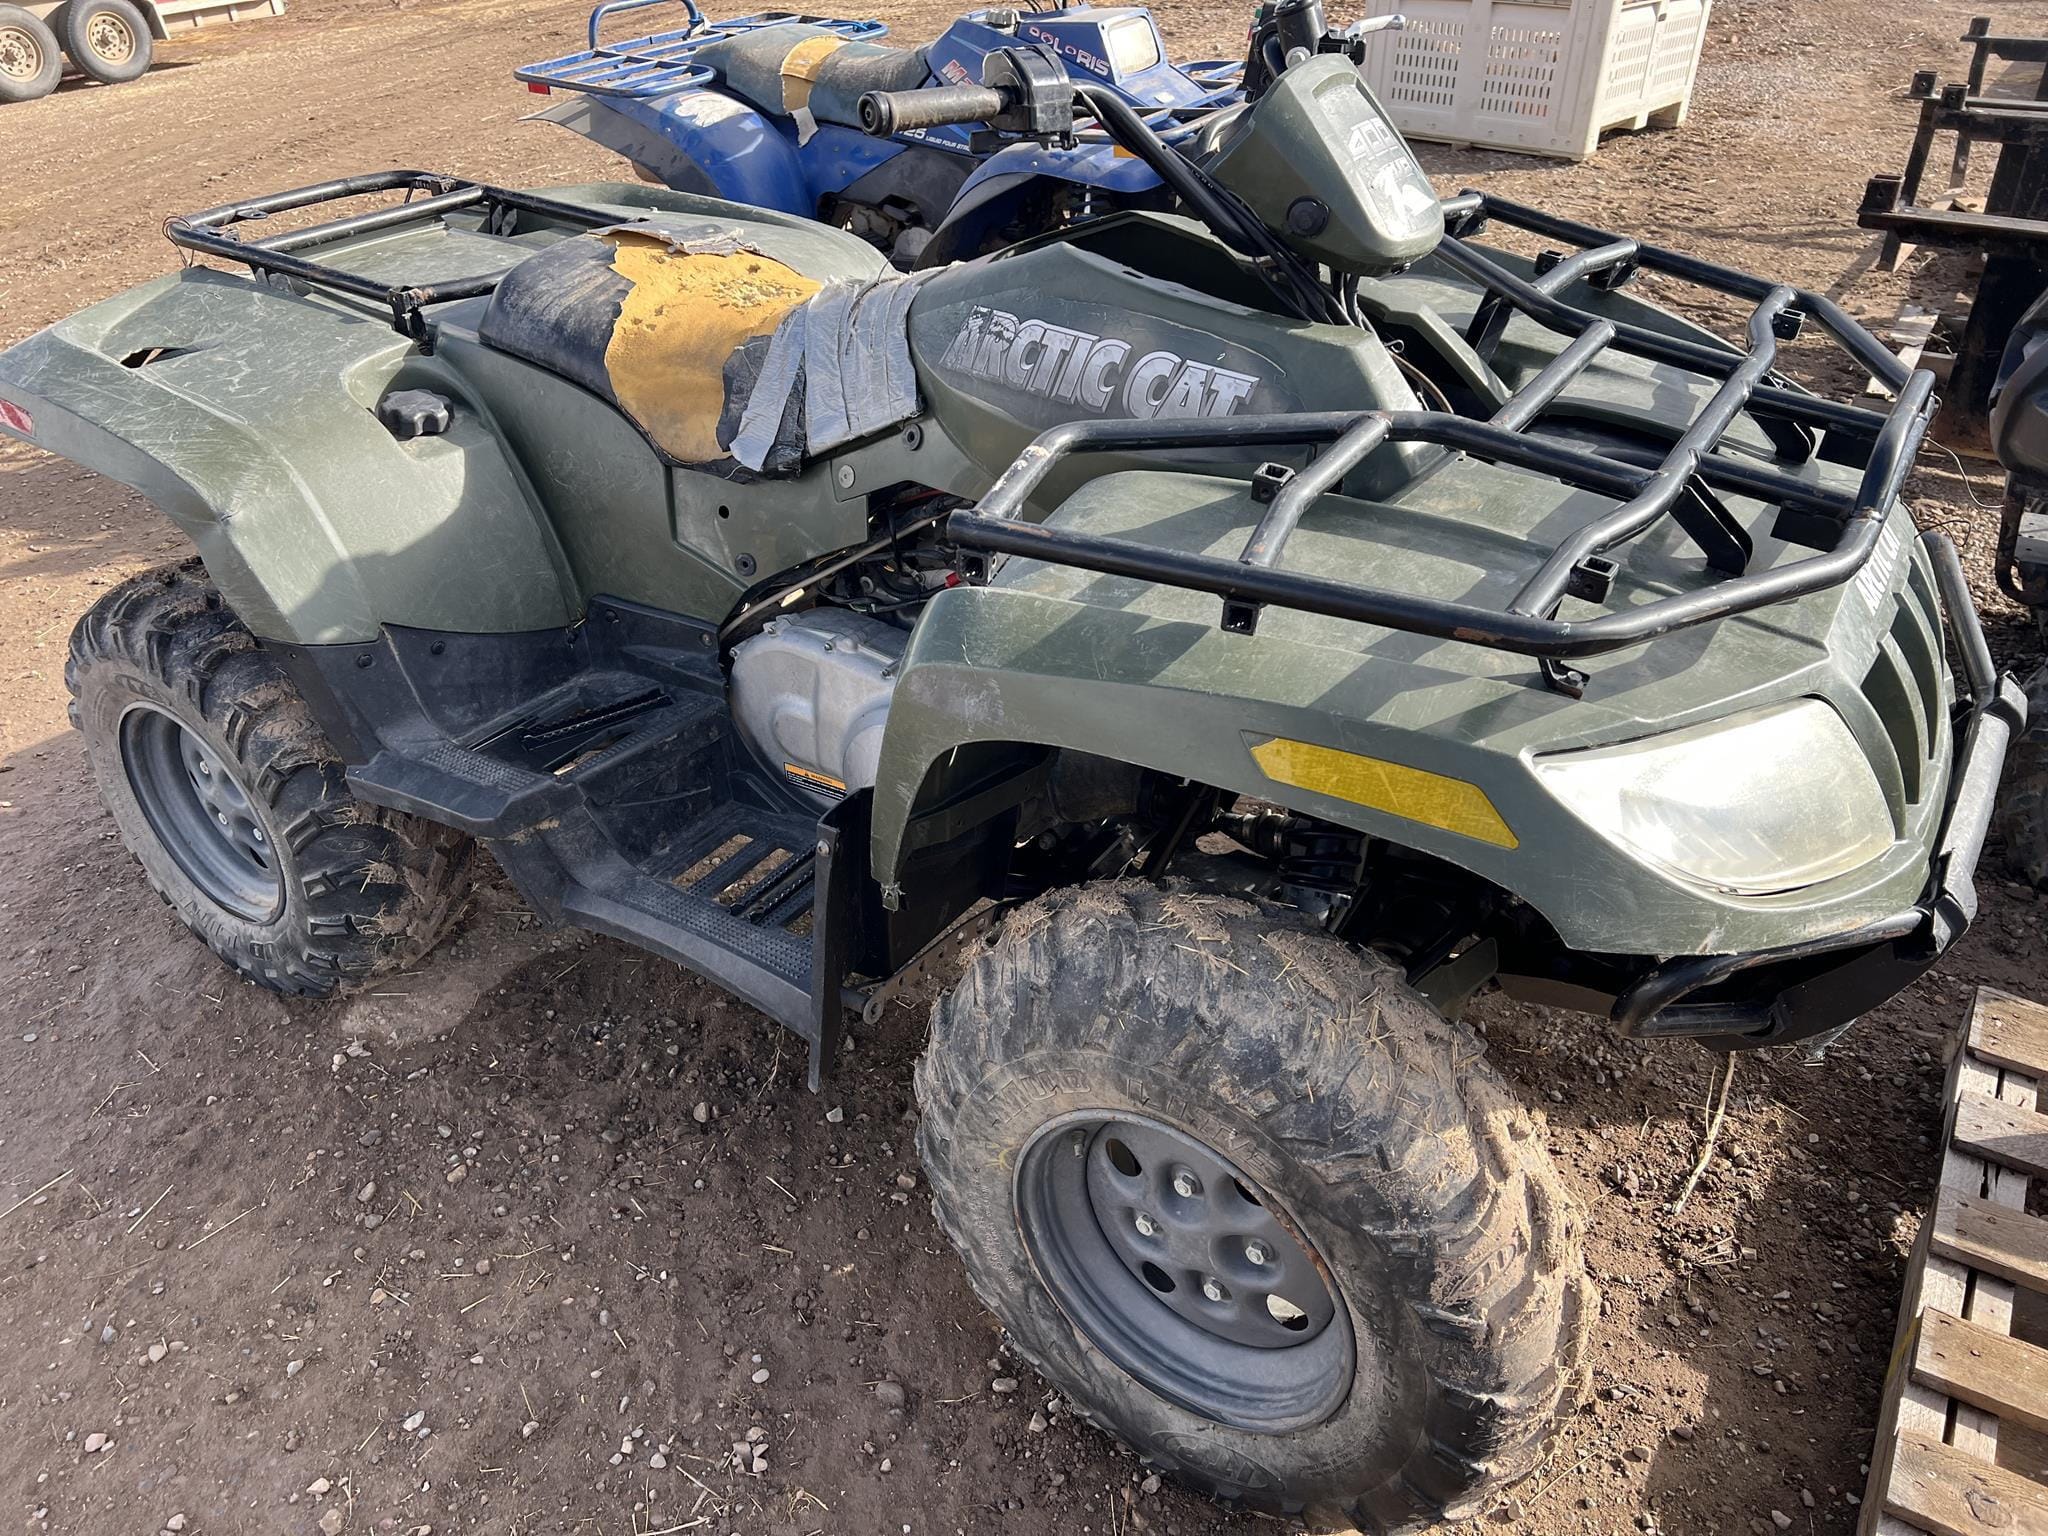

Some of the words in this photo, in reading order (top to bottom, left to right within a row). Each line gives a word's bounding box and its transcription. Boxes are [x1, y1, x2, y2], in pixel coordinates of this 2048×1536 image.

[1028, 25, 1110, 77] POLARIS
[898, 127, 927, 139] 25
[938, 305, 1133, 414] ARCTIC
[1122, 351, 1262, 418] CAT
